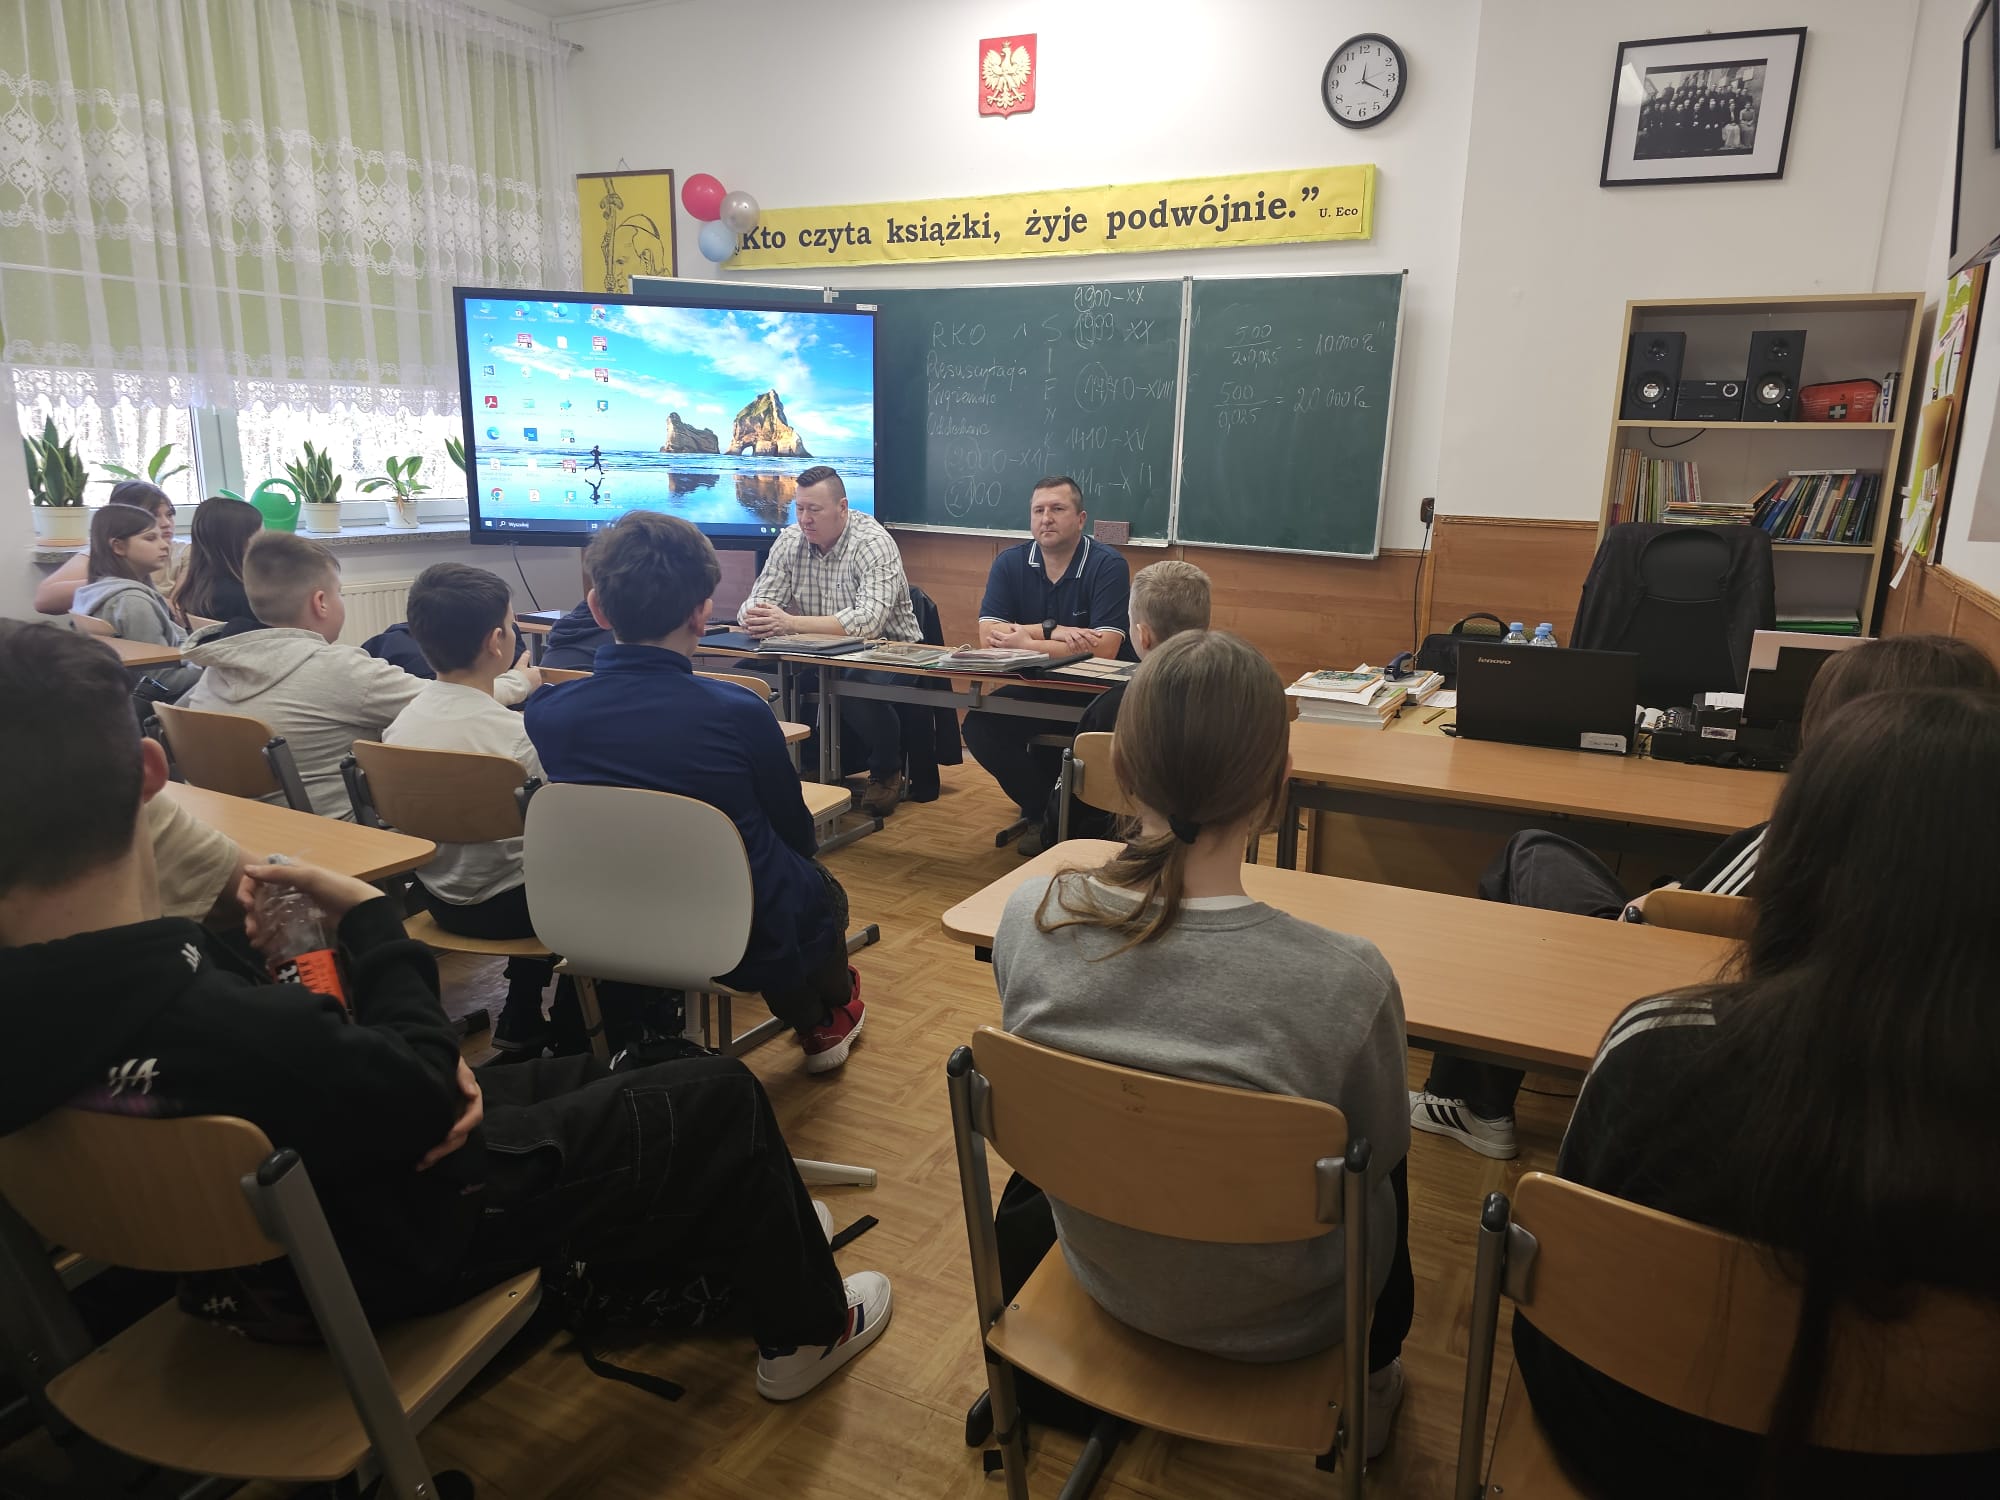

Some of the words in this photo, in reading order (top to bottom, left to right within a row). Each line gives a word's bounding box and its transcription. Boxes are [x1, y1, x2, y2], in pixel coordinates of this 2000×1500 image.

[1359, 44, 1371, 55] 12
[1377, 47, 1382, 57] 1
[1346, 52, 1355, 61] 11
[1385, 57, 1393, 67] 2
[1336, 64, 1347, 74] 10
[1387, 73, 1396, 82] 3
[1331, 79, 1339, 89] 9
[1382, 88, 1390, 99] 4
[1335, 94, 1343, 104] 8
[1345, 105, 1353, 116] 7
[1372, 101, 1381, 111] 5
[1358, 107, 1367, 117] 6
[1319, 207, 1332, 218] U.
[1336, 206, 1358, 217] Eco
[799, 221, 872, 254] czyta
[886, 211, 1001, 247] książki,
[1024, 205, 1088, 243] żyje
